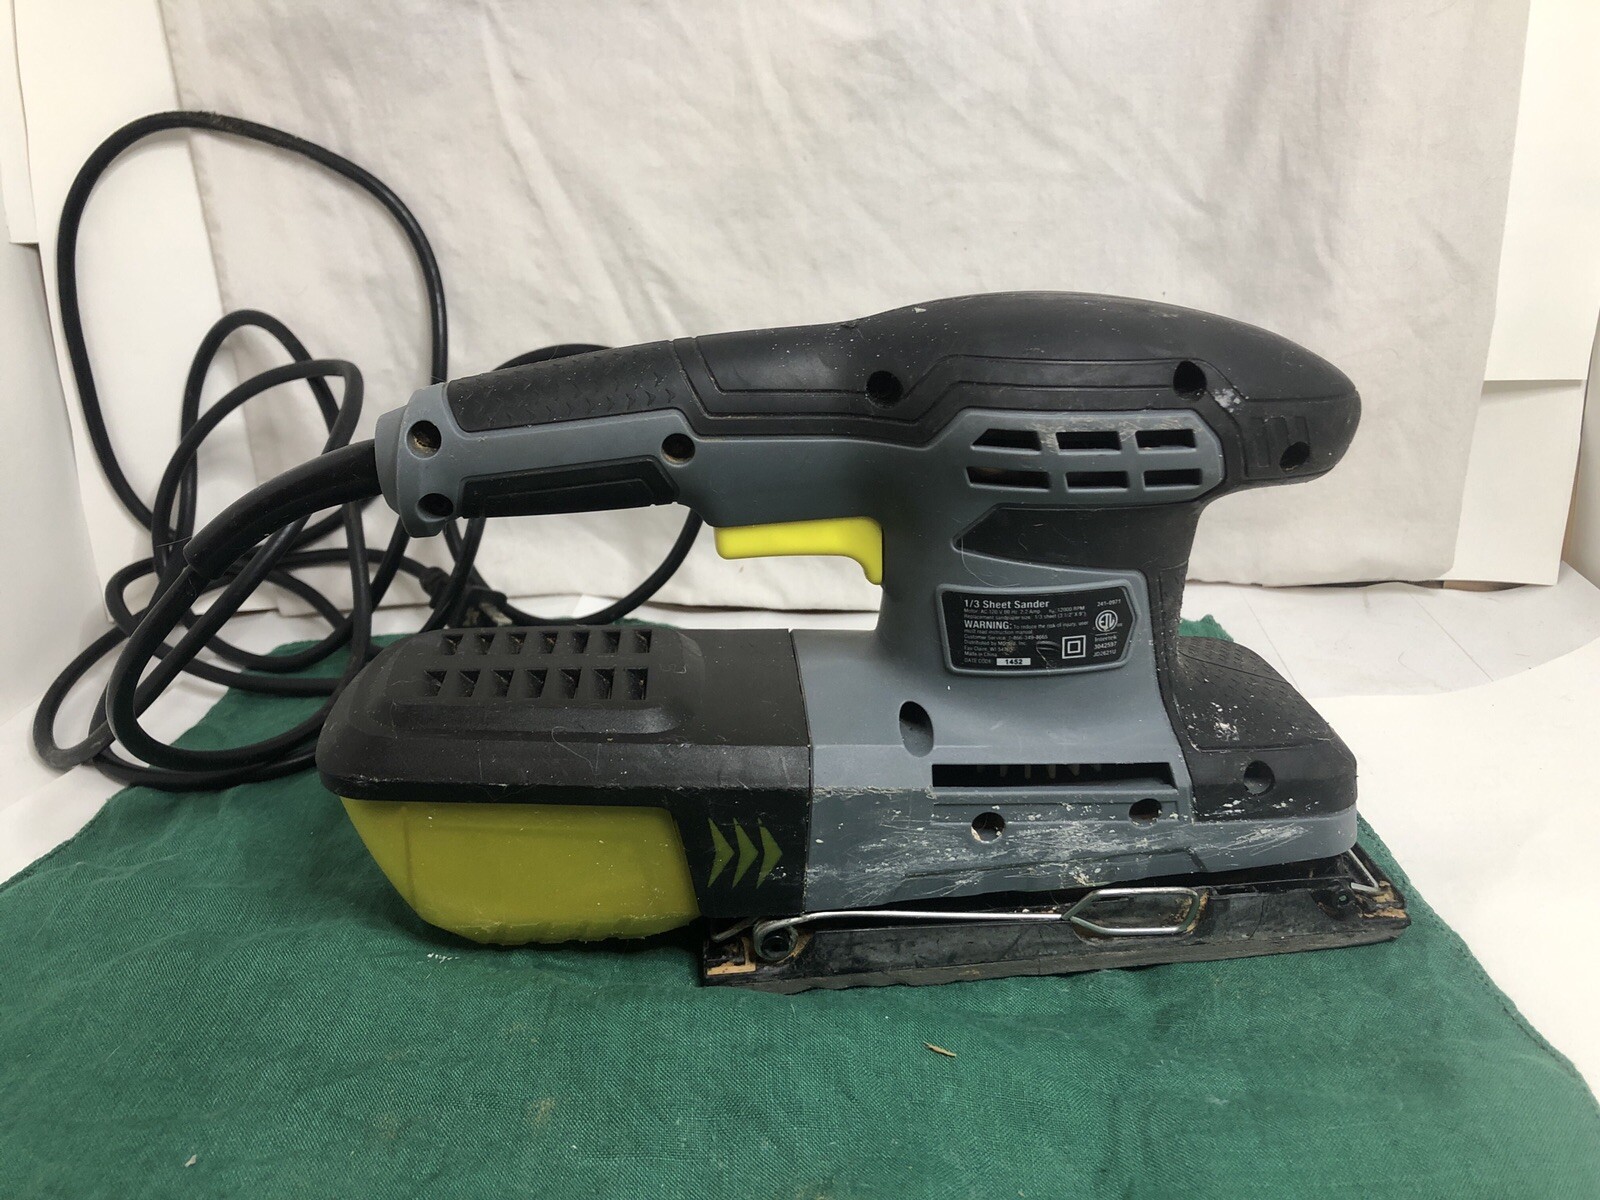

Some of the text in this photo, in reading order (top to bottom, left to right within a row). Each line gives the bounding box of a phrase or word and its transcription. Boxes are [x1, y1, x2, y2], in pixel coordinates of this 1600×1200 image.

[965, 600, 1050, 609] 1/3 Sheet Sander
[964, 620, 1012, 629] WARNING:
